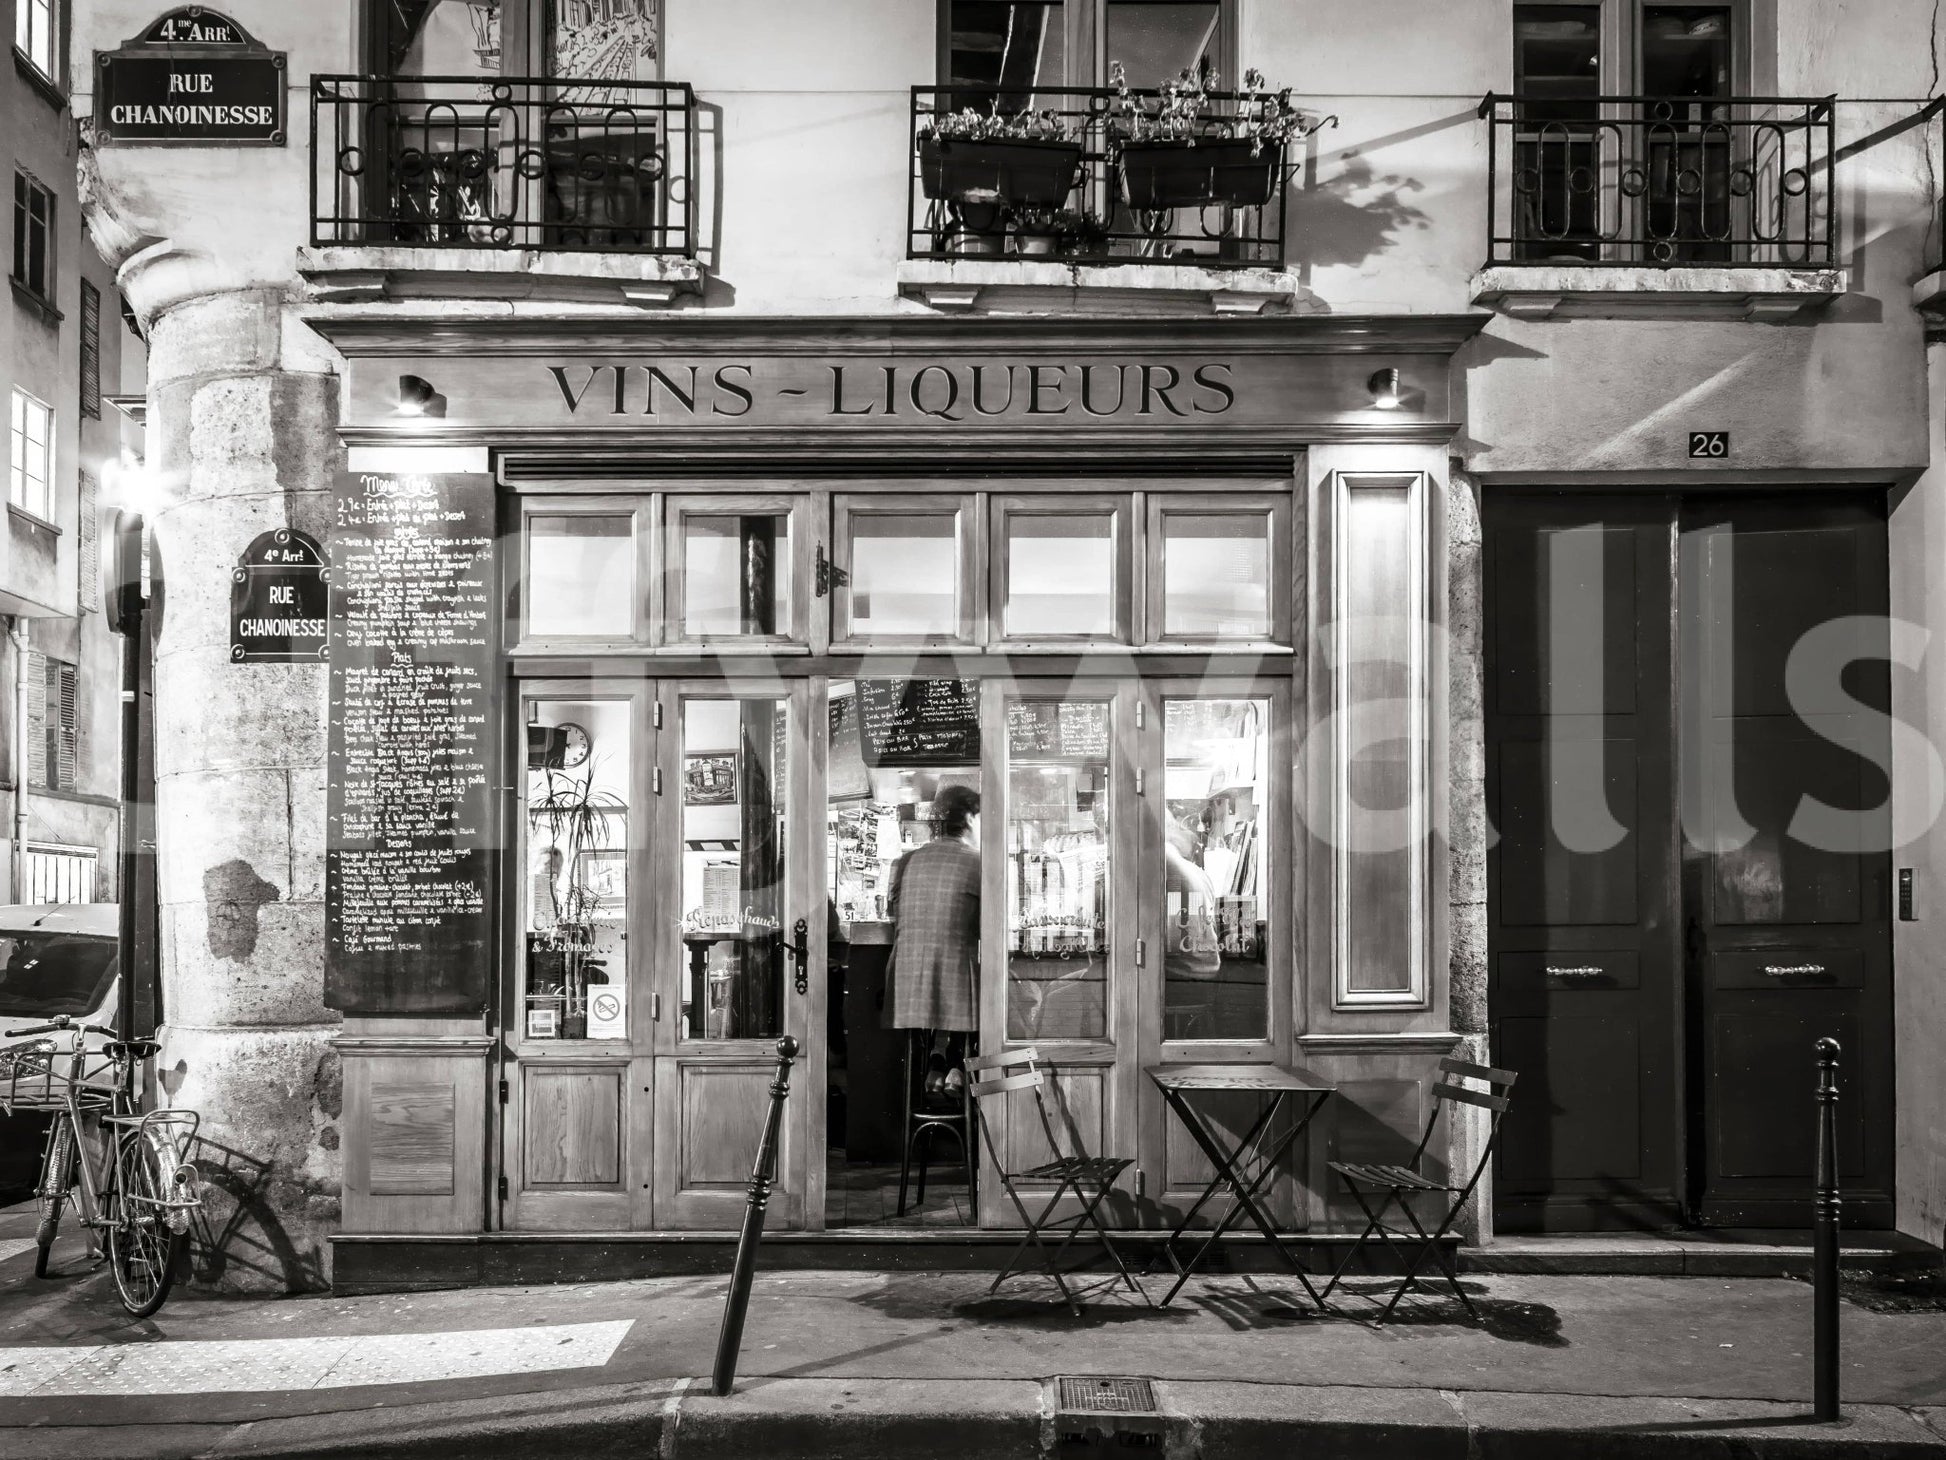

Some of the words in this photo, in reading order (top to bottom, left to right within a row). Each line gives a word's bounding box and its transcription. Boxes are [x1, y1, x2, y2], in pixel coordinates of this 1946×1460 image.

[168, 74, 213, 93] RUE
[110, 105, 273, 125] CHANOINESSE
[546, 363, 754, 417] VINS
[827, 362, 1236, 421] LIQUEURS
[1693, 434, 1724, 456] 26
[269, 586, 295, 604] RUE
[240, 618, 326, 637] CHANOINESSE
[845, 911, 854, 920] 51
